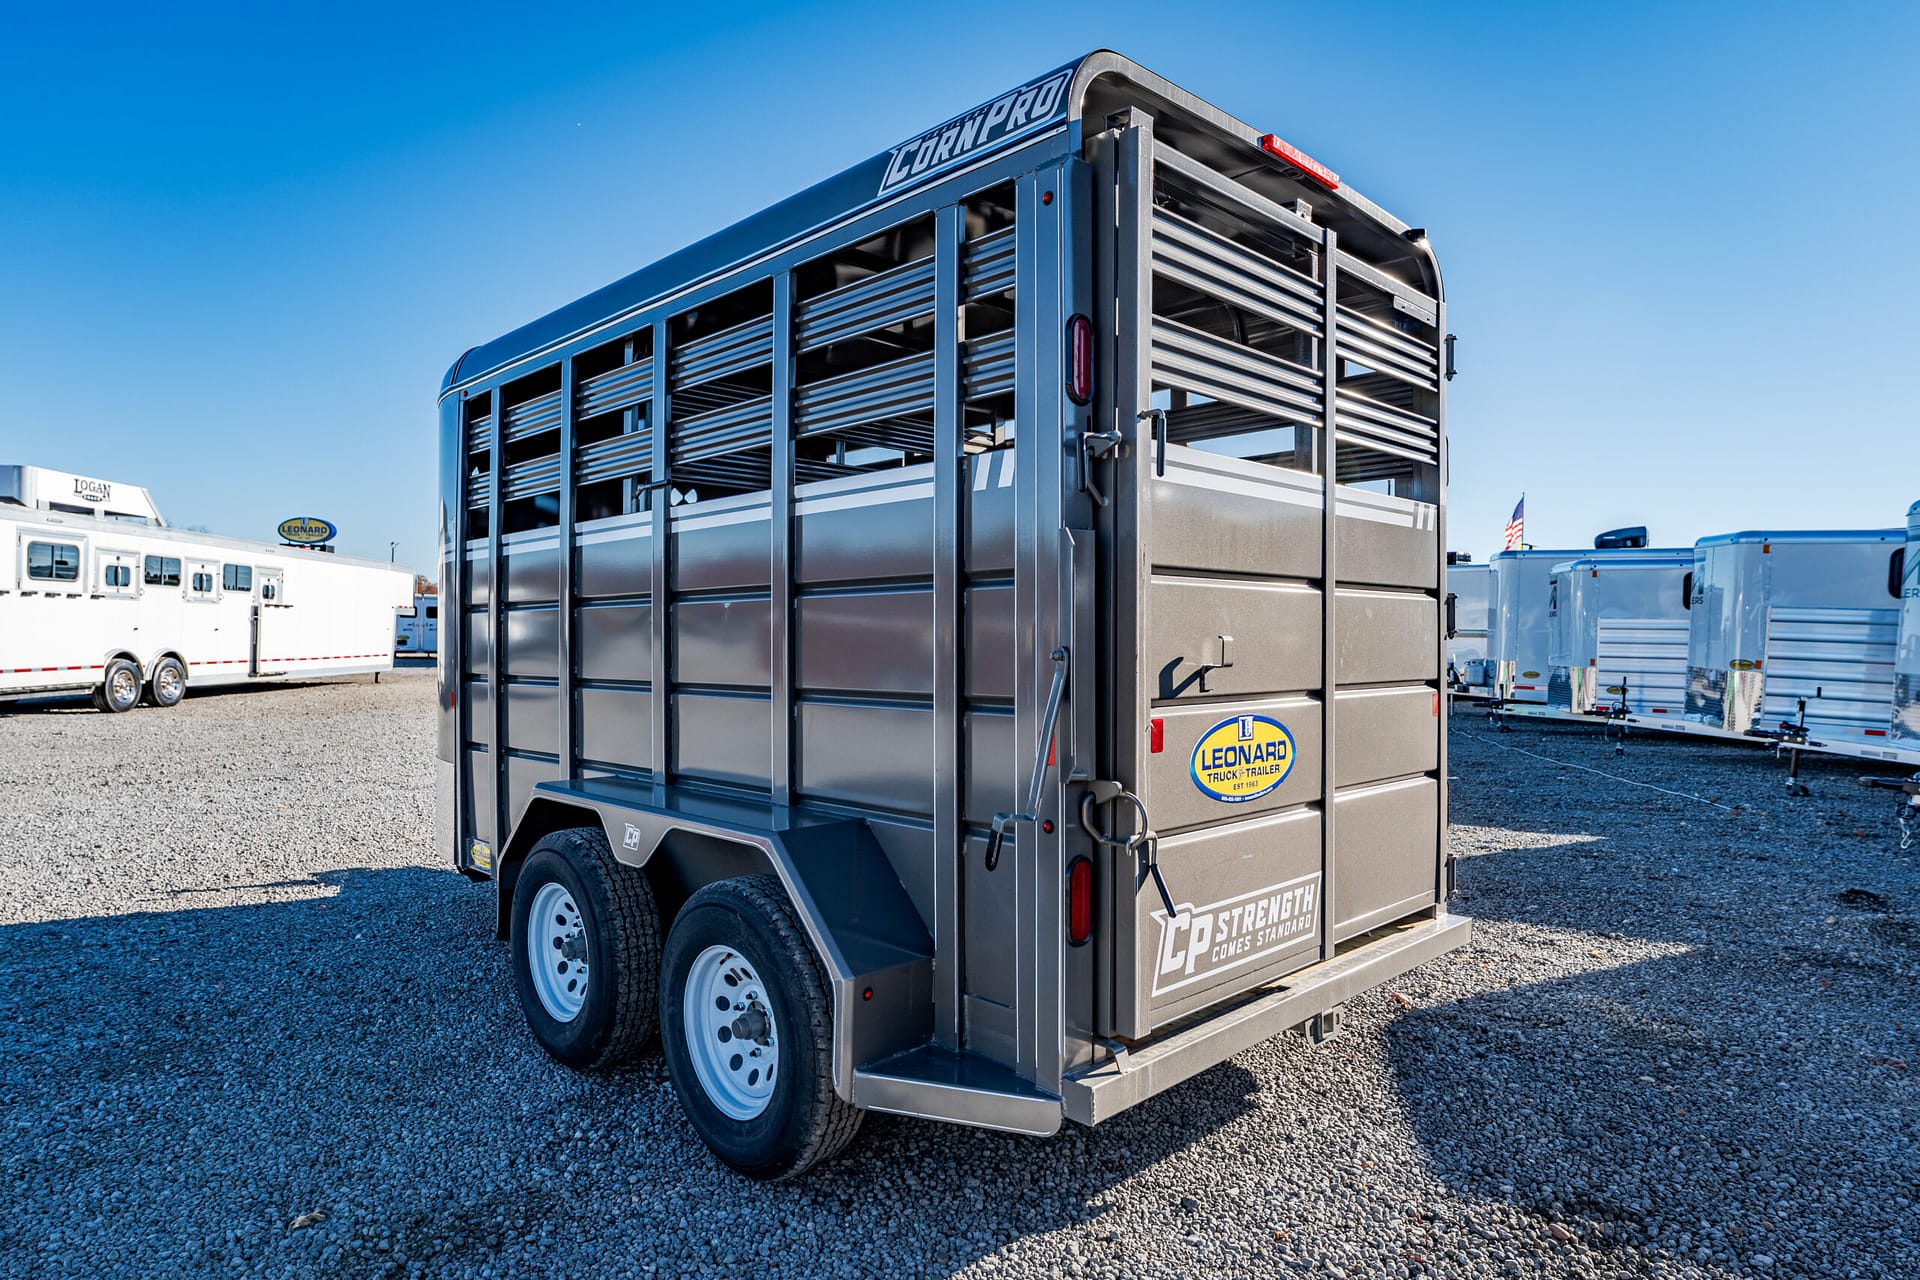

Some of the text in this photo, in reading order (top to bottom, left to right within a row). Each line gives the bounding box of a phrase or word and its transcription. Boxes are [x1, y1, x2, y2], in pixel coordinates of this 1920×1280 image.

[74, 478, 111, 499] LOGAN
[282, 525, 328, 534] LEONARD
[1201, 740, 1287, 771] LEONARD
[1207, 769, 1238, 784] TRUCK
[1245, 764, 1281, 778] TRAILER
[1233, 782, 1244, 790] EST
[626, 827, 639, 846] CP
[1160, 883, 1315, 975] CP STRENGTH
[1212, 913, 1311, 963] COMES STANDARD
